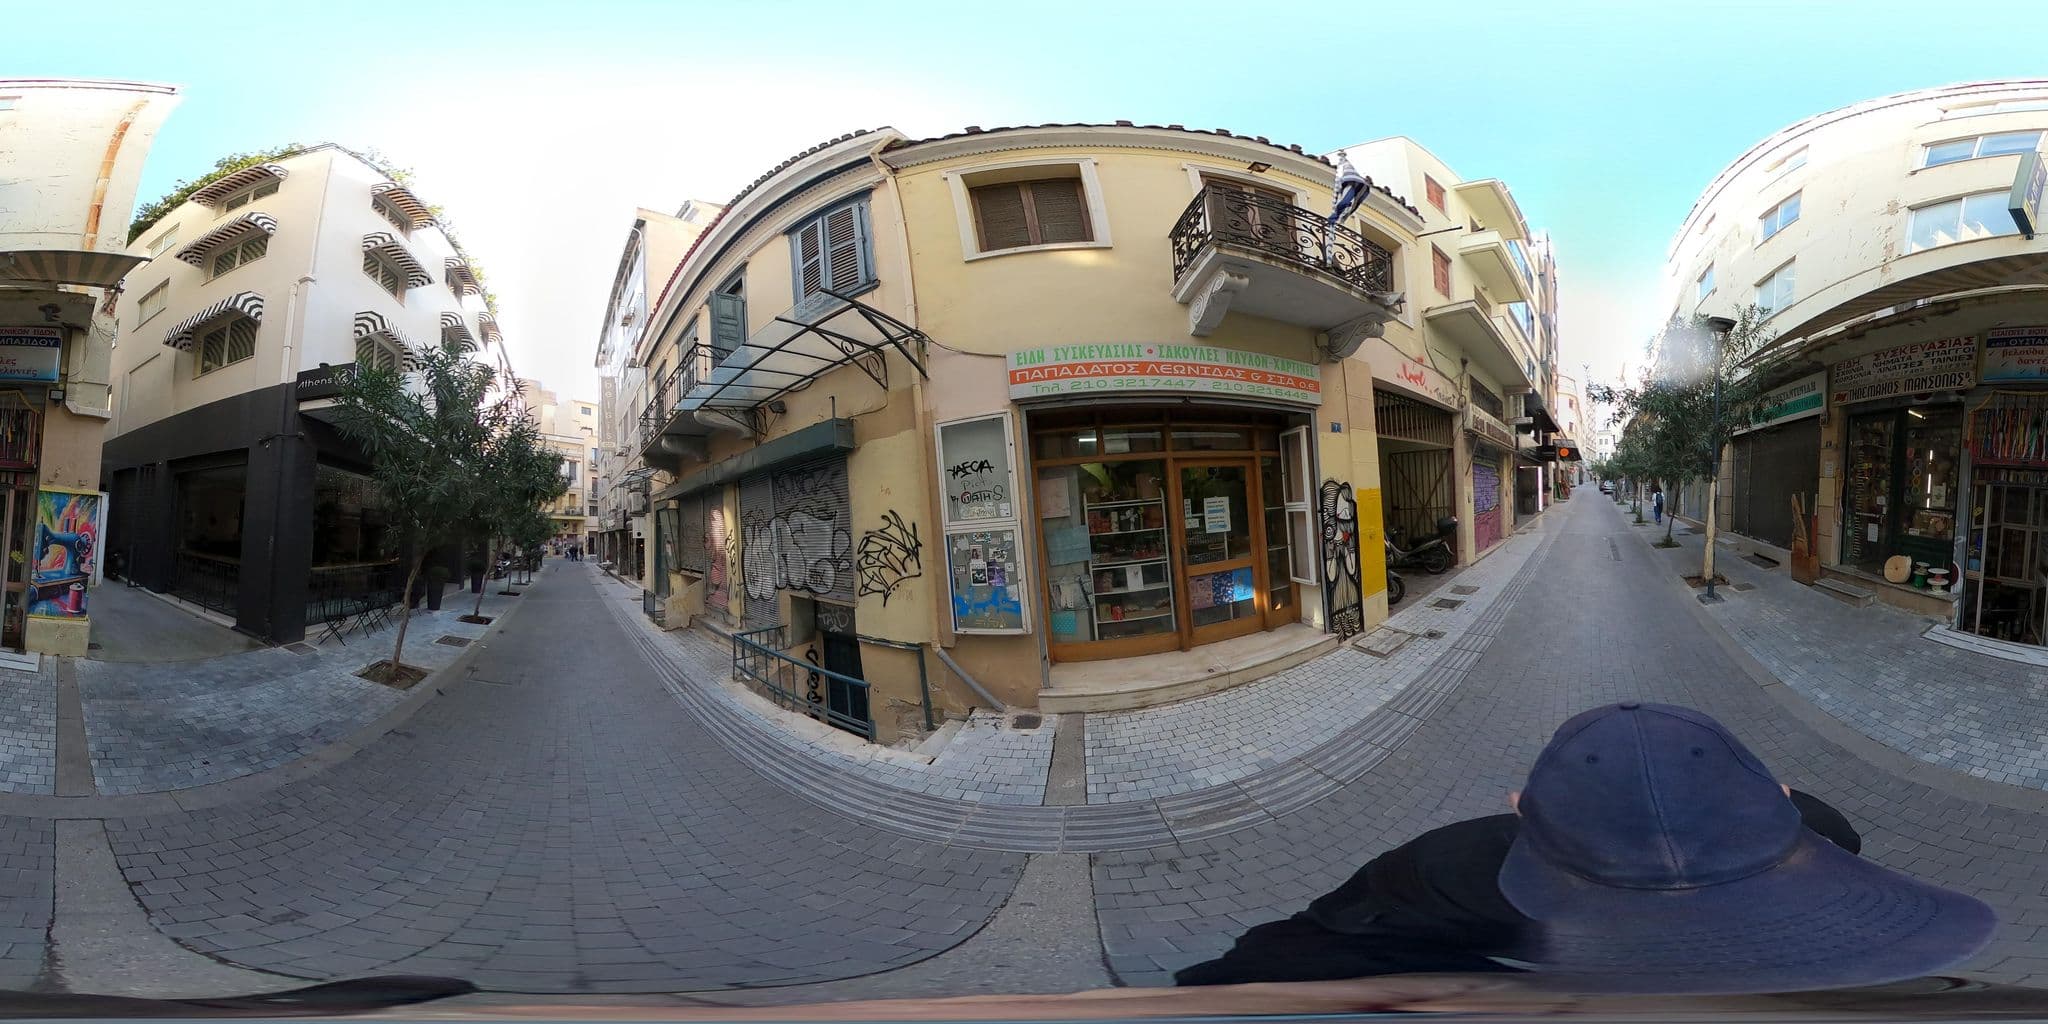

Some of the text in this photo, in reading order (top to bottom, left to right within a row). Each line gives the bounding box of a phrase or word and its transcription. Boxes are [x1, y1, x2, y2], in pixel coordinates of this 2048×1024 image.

[1016, 350, 1045, 367] ΕΙΔΗ
[1054, 344, 1143, 361] ΣΥΣΚΕΥΑΣΙΑΣ
[1158, 344, 1219, 362] ΣΑΚΟΥΛΕΣ
[1836, 359, 1861, 372] ΕΙΔΗ
[1873, 336, 1974, 362] ΣΥΣΚΕΥΑΣΙΑΣ
[1872, 355, 1912, 369] ΝΗΜΑΤΑ
[1923, 346, 1975, 358] ΣΠΑΓΓΟΙ
[1930, 353, 1973, 365] ΤΑΙΝΙΕΣ
[1016, 364, 1140, 382] ΠΑΠΑΔΑΤΟΣ
[1146, 364, 1246, 379] ΛΕΩΝΙΔΑΣ
[1267, 374, 1297, 387] ΣΙΑ
